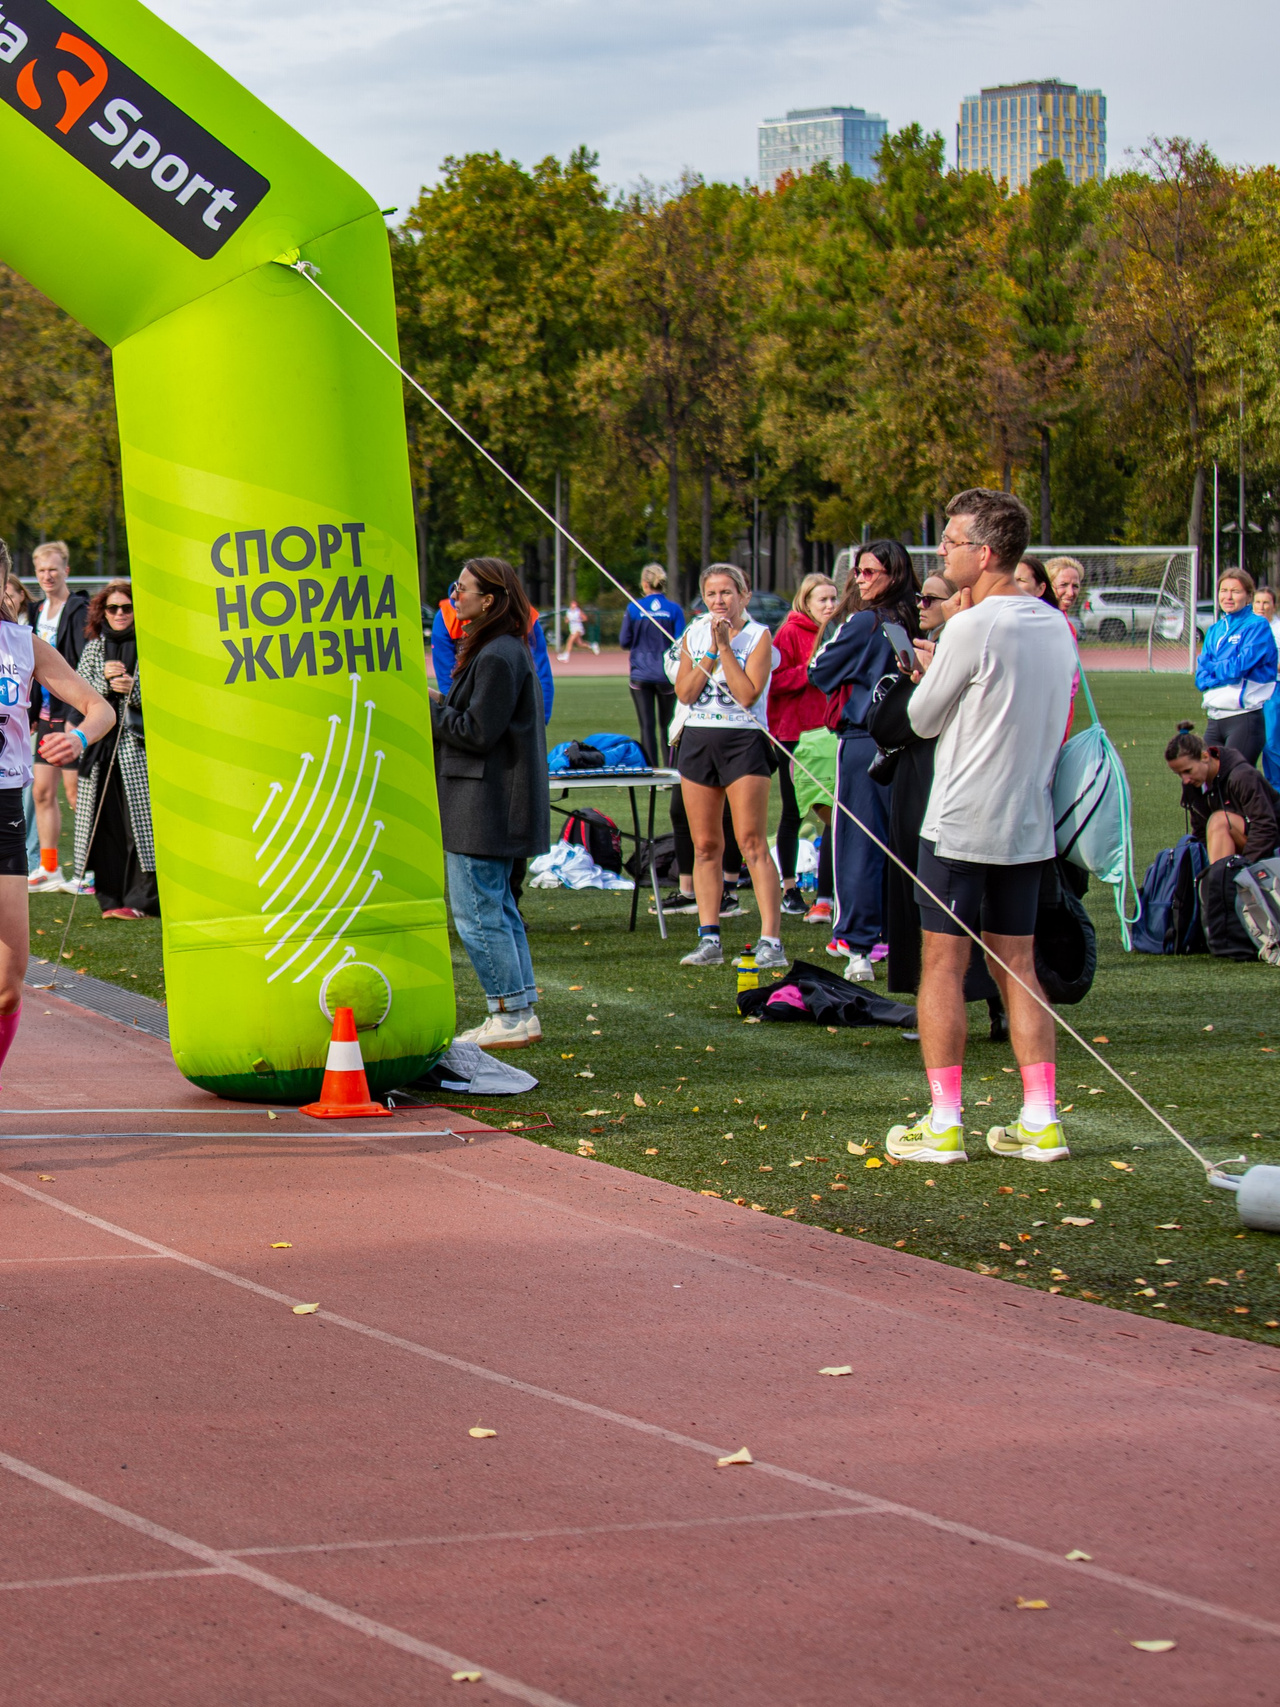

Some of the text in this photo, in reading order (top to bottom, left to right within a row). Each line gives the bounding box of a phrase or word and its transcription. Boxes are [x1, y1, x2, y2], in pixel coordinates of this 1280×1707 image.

[88, 97, 238, 231] Sport
[211, 522, 366, 578] СПОРТ
[215, 574, 397, 632] НОРМА
[221, 626, 403, 686] ЖИЗНИ
